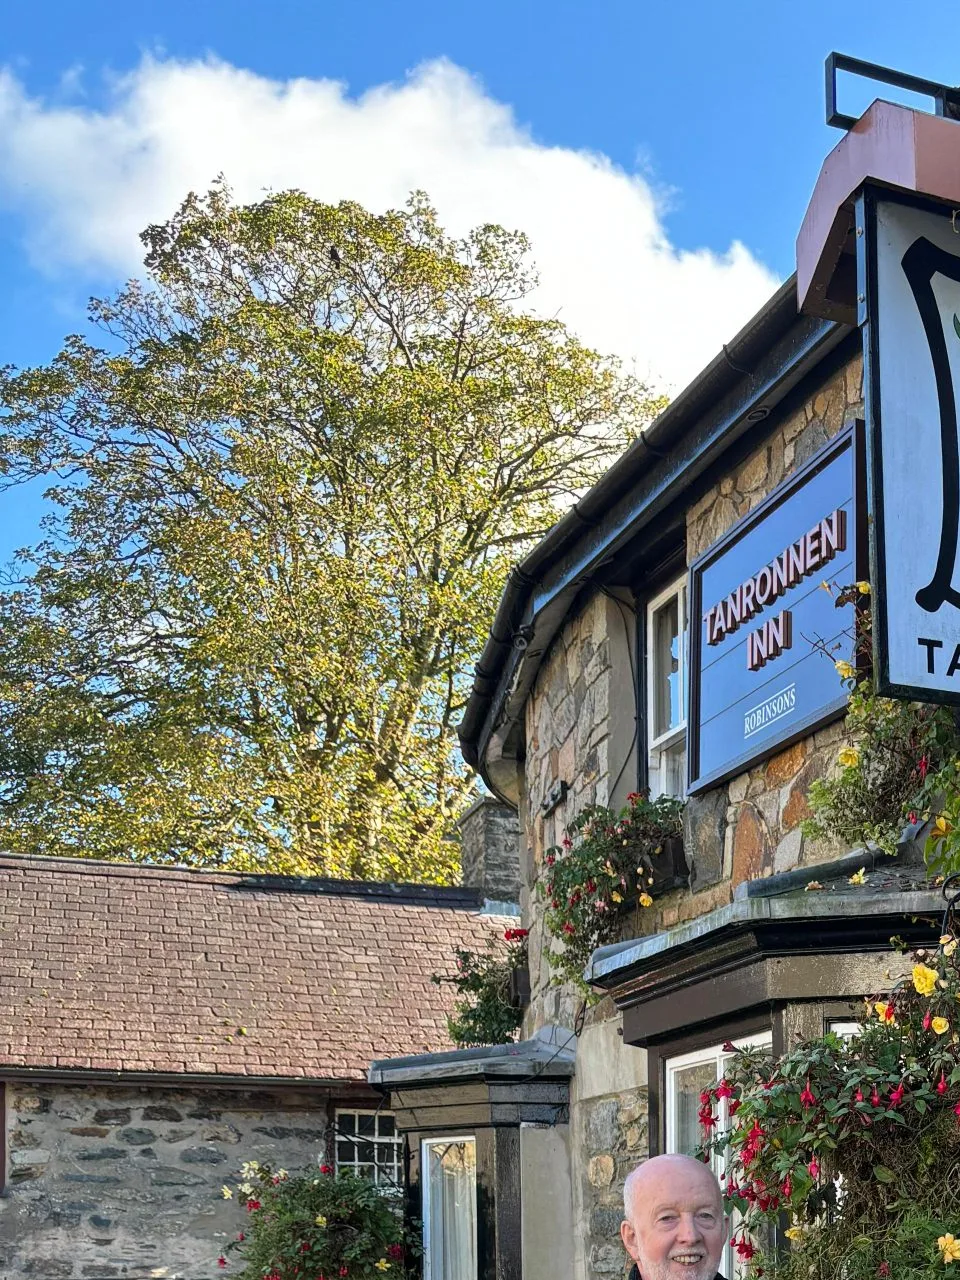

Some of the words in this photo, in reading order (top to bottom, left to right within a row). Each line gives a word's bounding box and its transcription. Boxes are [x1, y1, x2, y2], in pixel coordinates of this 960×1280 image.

[702, 509, 847, 645] TANRONNEN
[747, 610, 792, 671] INN
[744, 688, 796, 734] ROBINSONS
